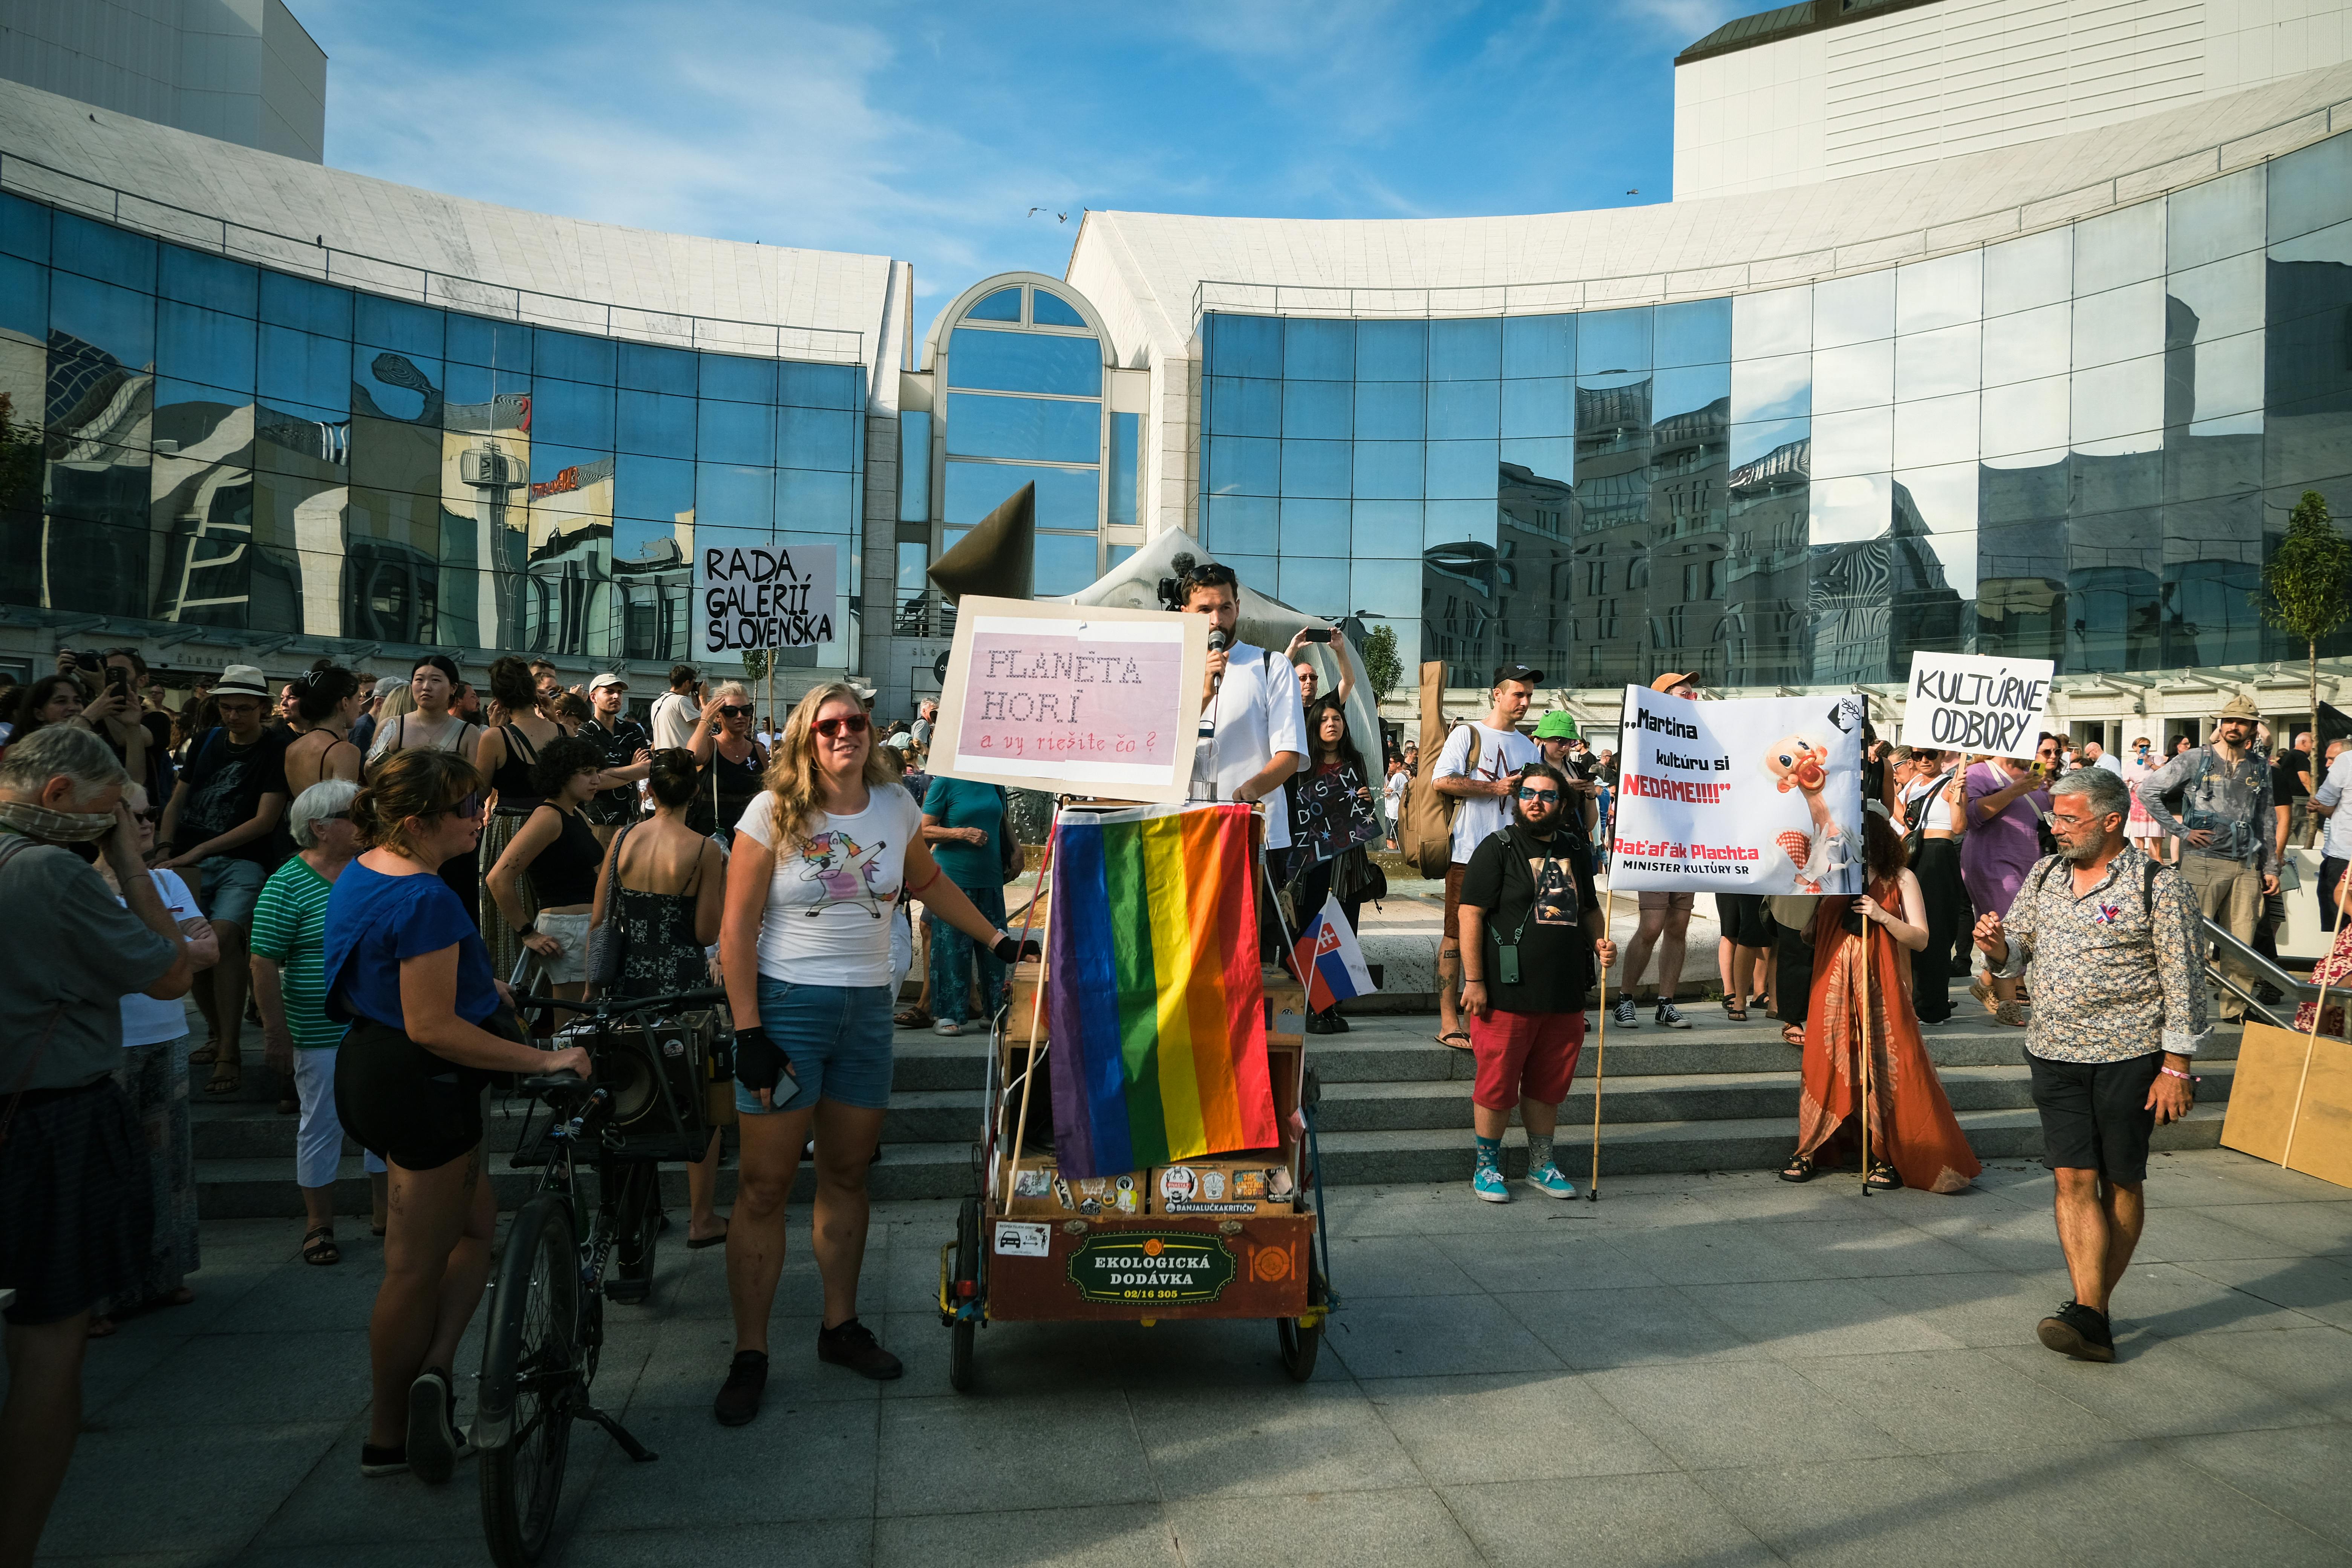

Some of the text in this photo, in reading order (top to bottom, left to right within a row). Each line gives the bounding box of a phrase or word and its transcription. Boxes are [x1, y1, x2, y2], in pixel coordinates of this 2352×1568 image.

[706, 548, 797, 583] RADA
[706, 573, 812, 618] GALÉRIÍ
[706, 613, 833, 653] SLOVENSKA
[177, 653, 243, 666] ČINOHRA
[1917, 668, 2049, 712] KULTÚRNE
[981, 689, 1084, 723] HORÍ
[1932, 707, 2030, 752] ODBORY
[980, 731, 1156, 756] a vy riešite čo ?
[1656, 749, 1730, 771] kultúru si
[1690, 844, 1759, 860] Plachta
[1623, 860, 1749, 874] MINISTER KULTÚRY SR
[1095, 1254, 1210, 1269] EKOLOGICKÁ
[1110, 1271, 1194, 1285] DODÁVKA
[1124, 1289, 1178, 1298] 02/16 305
